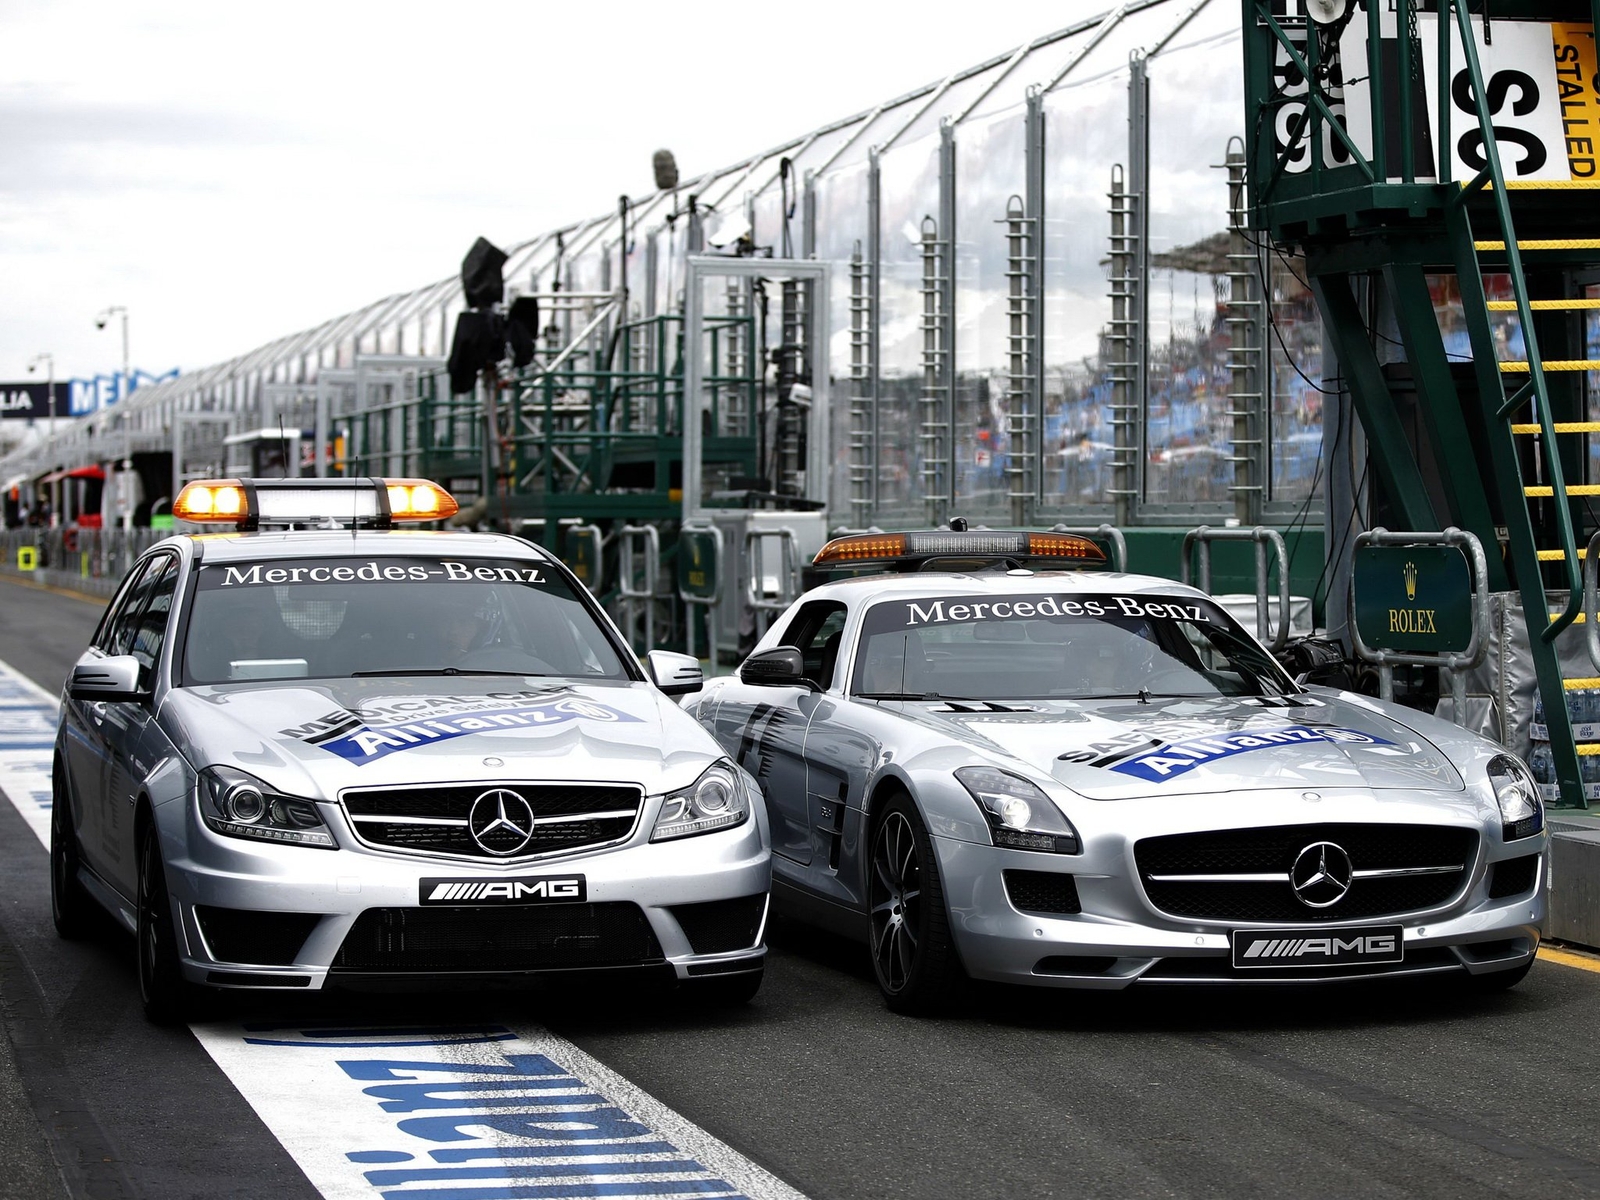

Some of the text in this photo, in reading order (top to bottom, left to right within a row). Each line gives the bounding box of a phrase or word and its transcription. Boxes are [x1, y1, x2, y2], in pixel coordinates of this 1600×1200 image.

[1451, 67, 1548, 176] SC
[1553, 43, 1597, 178] STALLED
[0, 390, 34, 411] LIA
[221, 562, 547, 586] Mercedes-Benz
[906, 596, 1210, 625] Mercedes-Benz
[1388, 608, 1437, 633] ROLEX
[277, 697, 479, 739] MEDICAL
[347, 710, 562, 757] Allianz
[1134, 728, 1325, 776] Allianz
[477, 879, 579, 900] AMG
[1293, 935, 1396, 957] AMG
[335, 1053, 752, 1200] llianz
